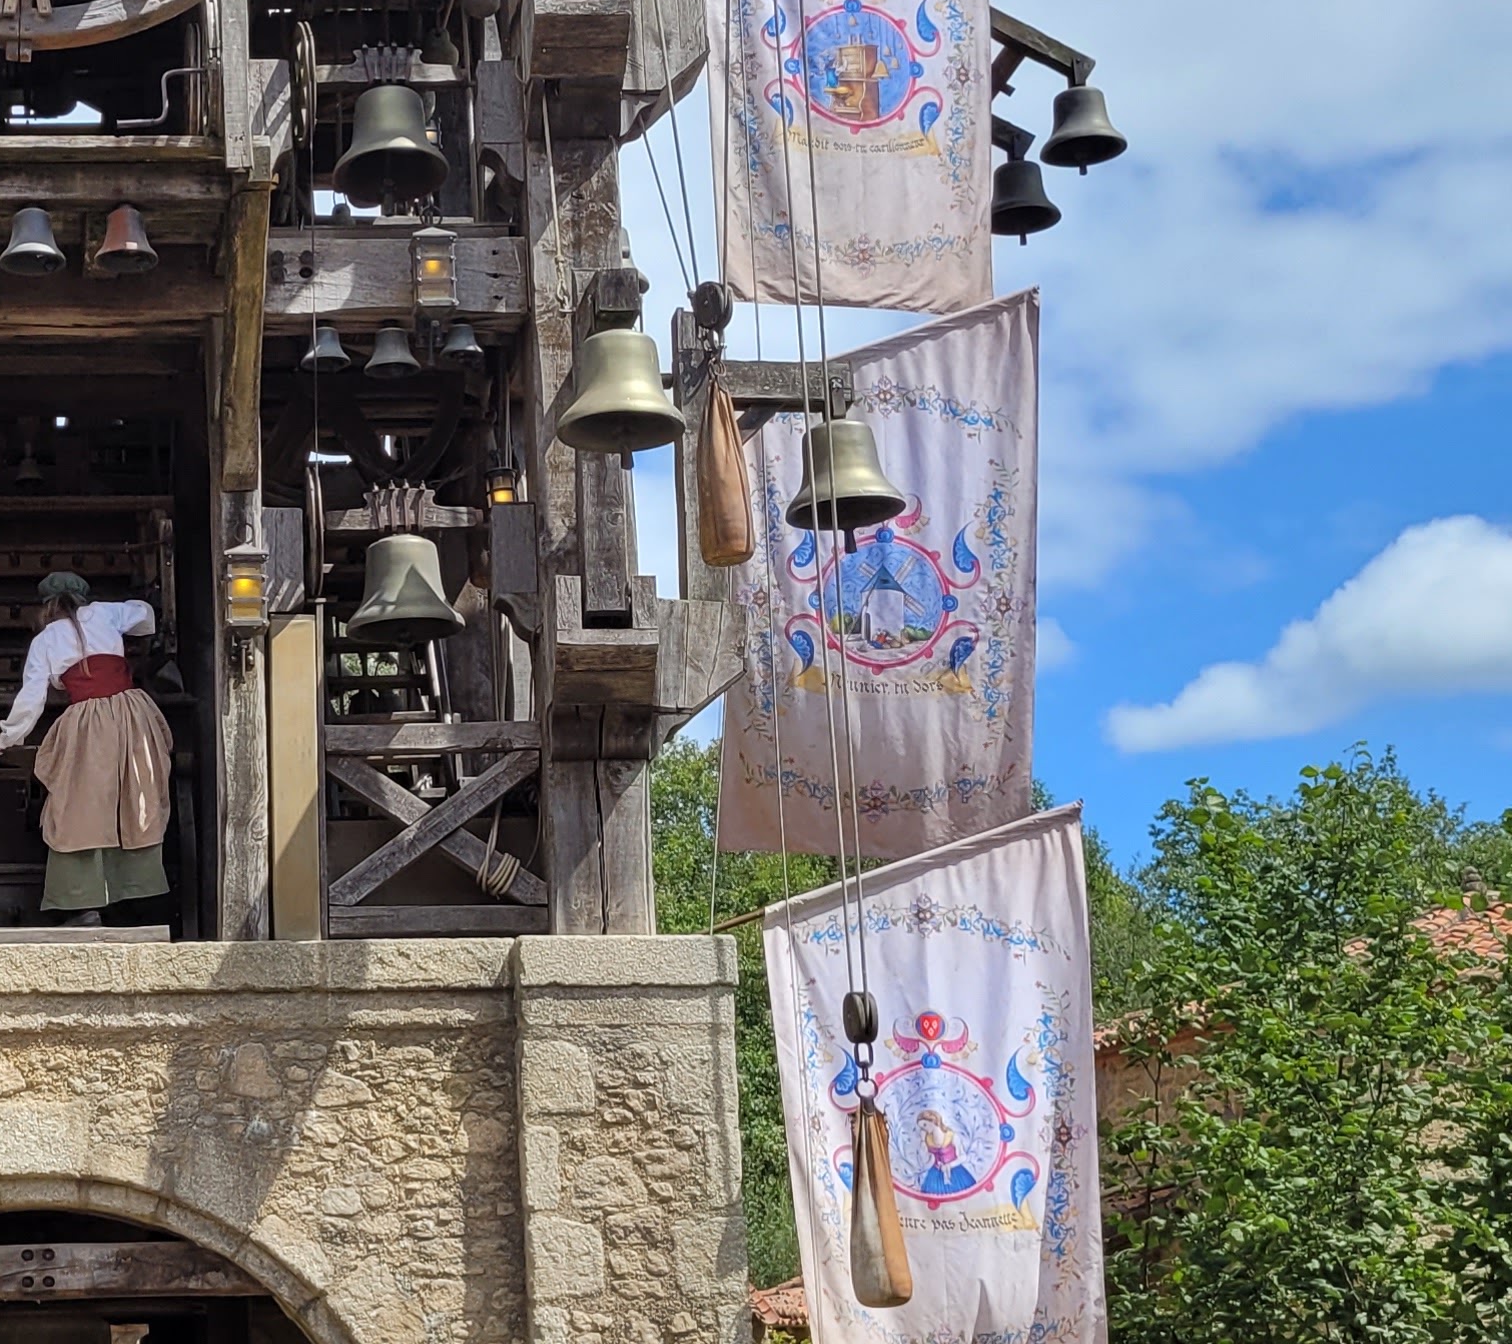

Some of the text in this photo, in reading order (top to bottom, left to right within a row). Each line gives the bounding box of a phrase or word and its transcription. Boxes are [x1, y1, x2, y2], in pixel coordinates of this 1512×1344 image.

[787, 128, 830, 150] Madit
[823, 671, 944, 695] Munier, tu dors
[931, 1218, 956, 1236] pas
[959, 1211, 1019, 1233] Jeannette
